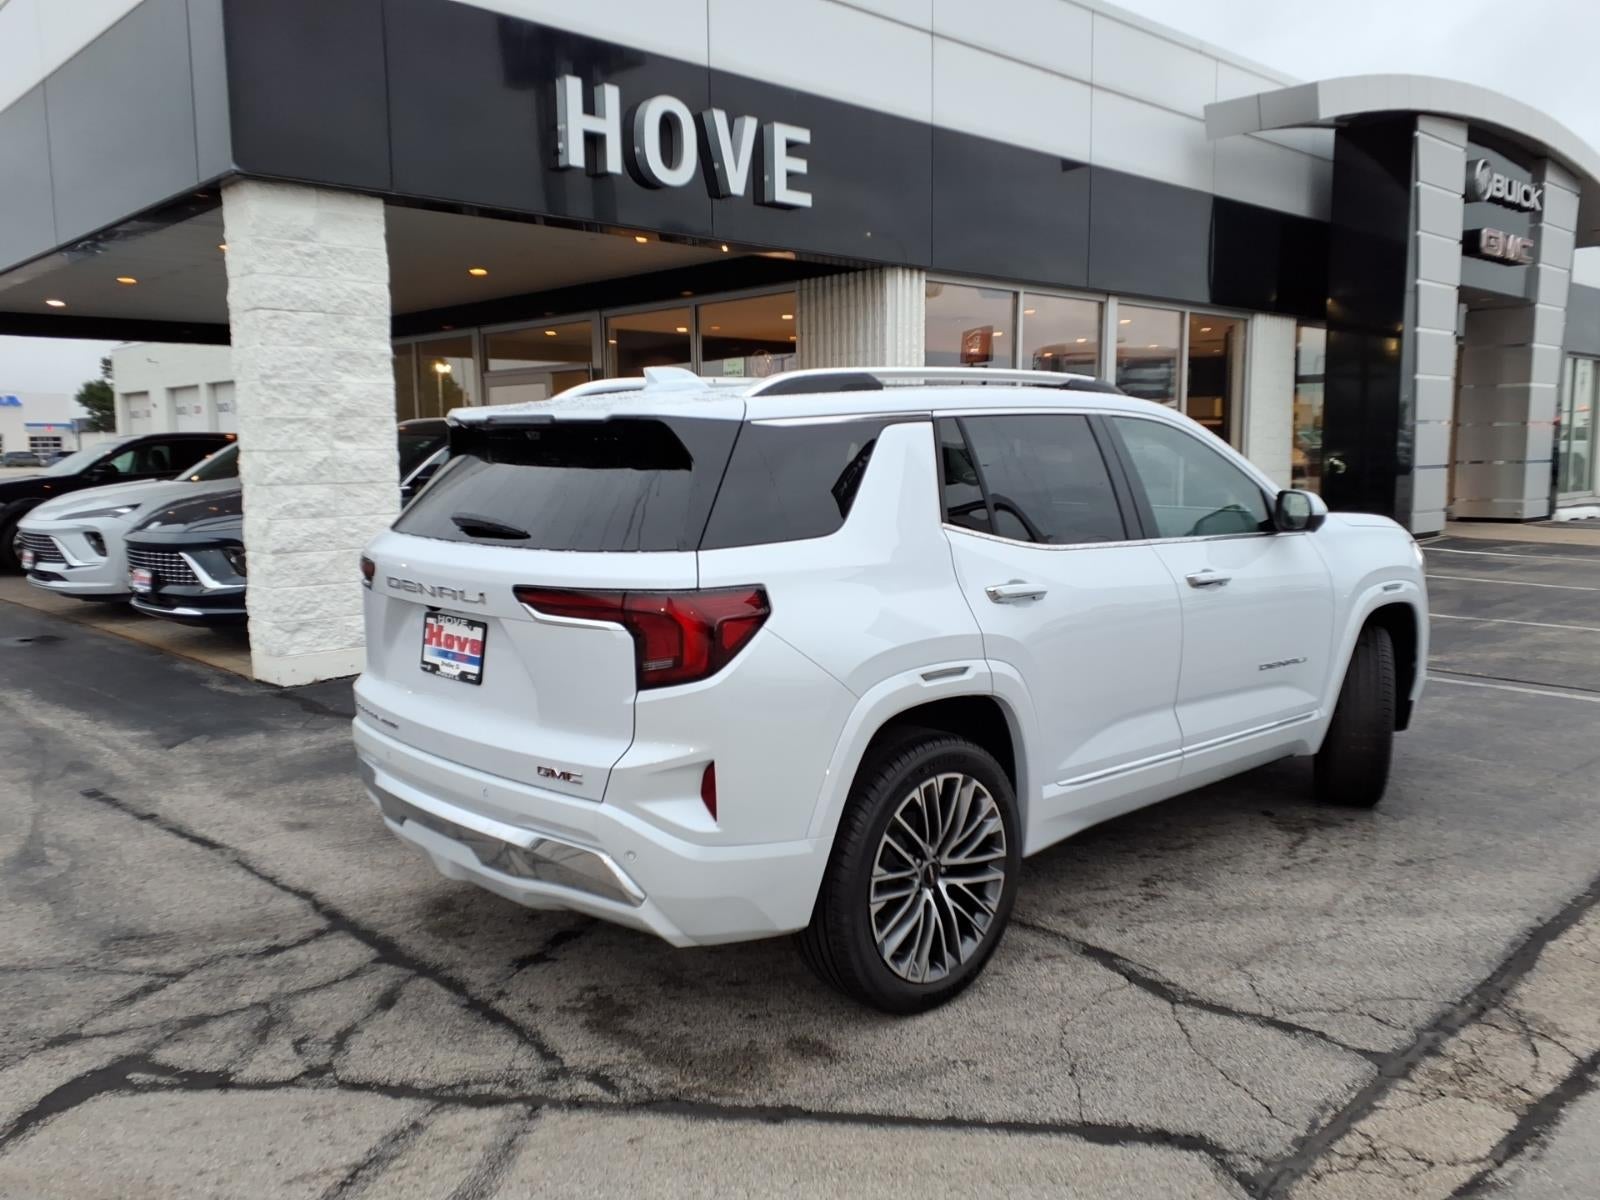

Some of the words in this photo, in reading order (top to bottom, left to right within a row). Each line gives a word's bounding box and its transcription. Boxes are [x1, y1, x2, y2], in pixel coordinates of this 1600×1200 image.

[556, 75, 812, 207] HOVE
[1491, 174, 1543, 210] BUICK
[1481, 228, 1534, 263] GMC
[386, 576, 486, 604] DENALI
[437, 615, 468, 626] HOVE
[424, 623, 484, 656] Hove
[537, 766, 583, 784] GMC
